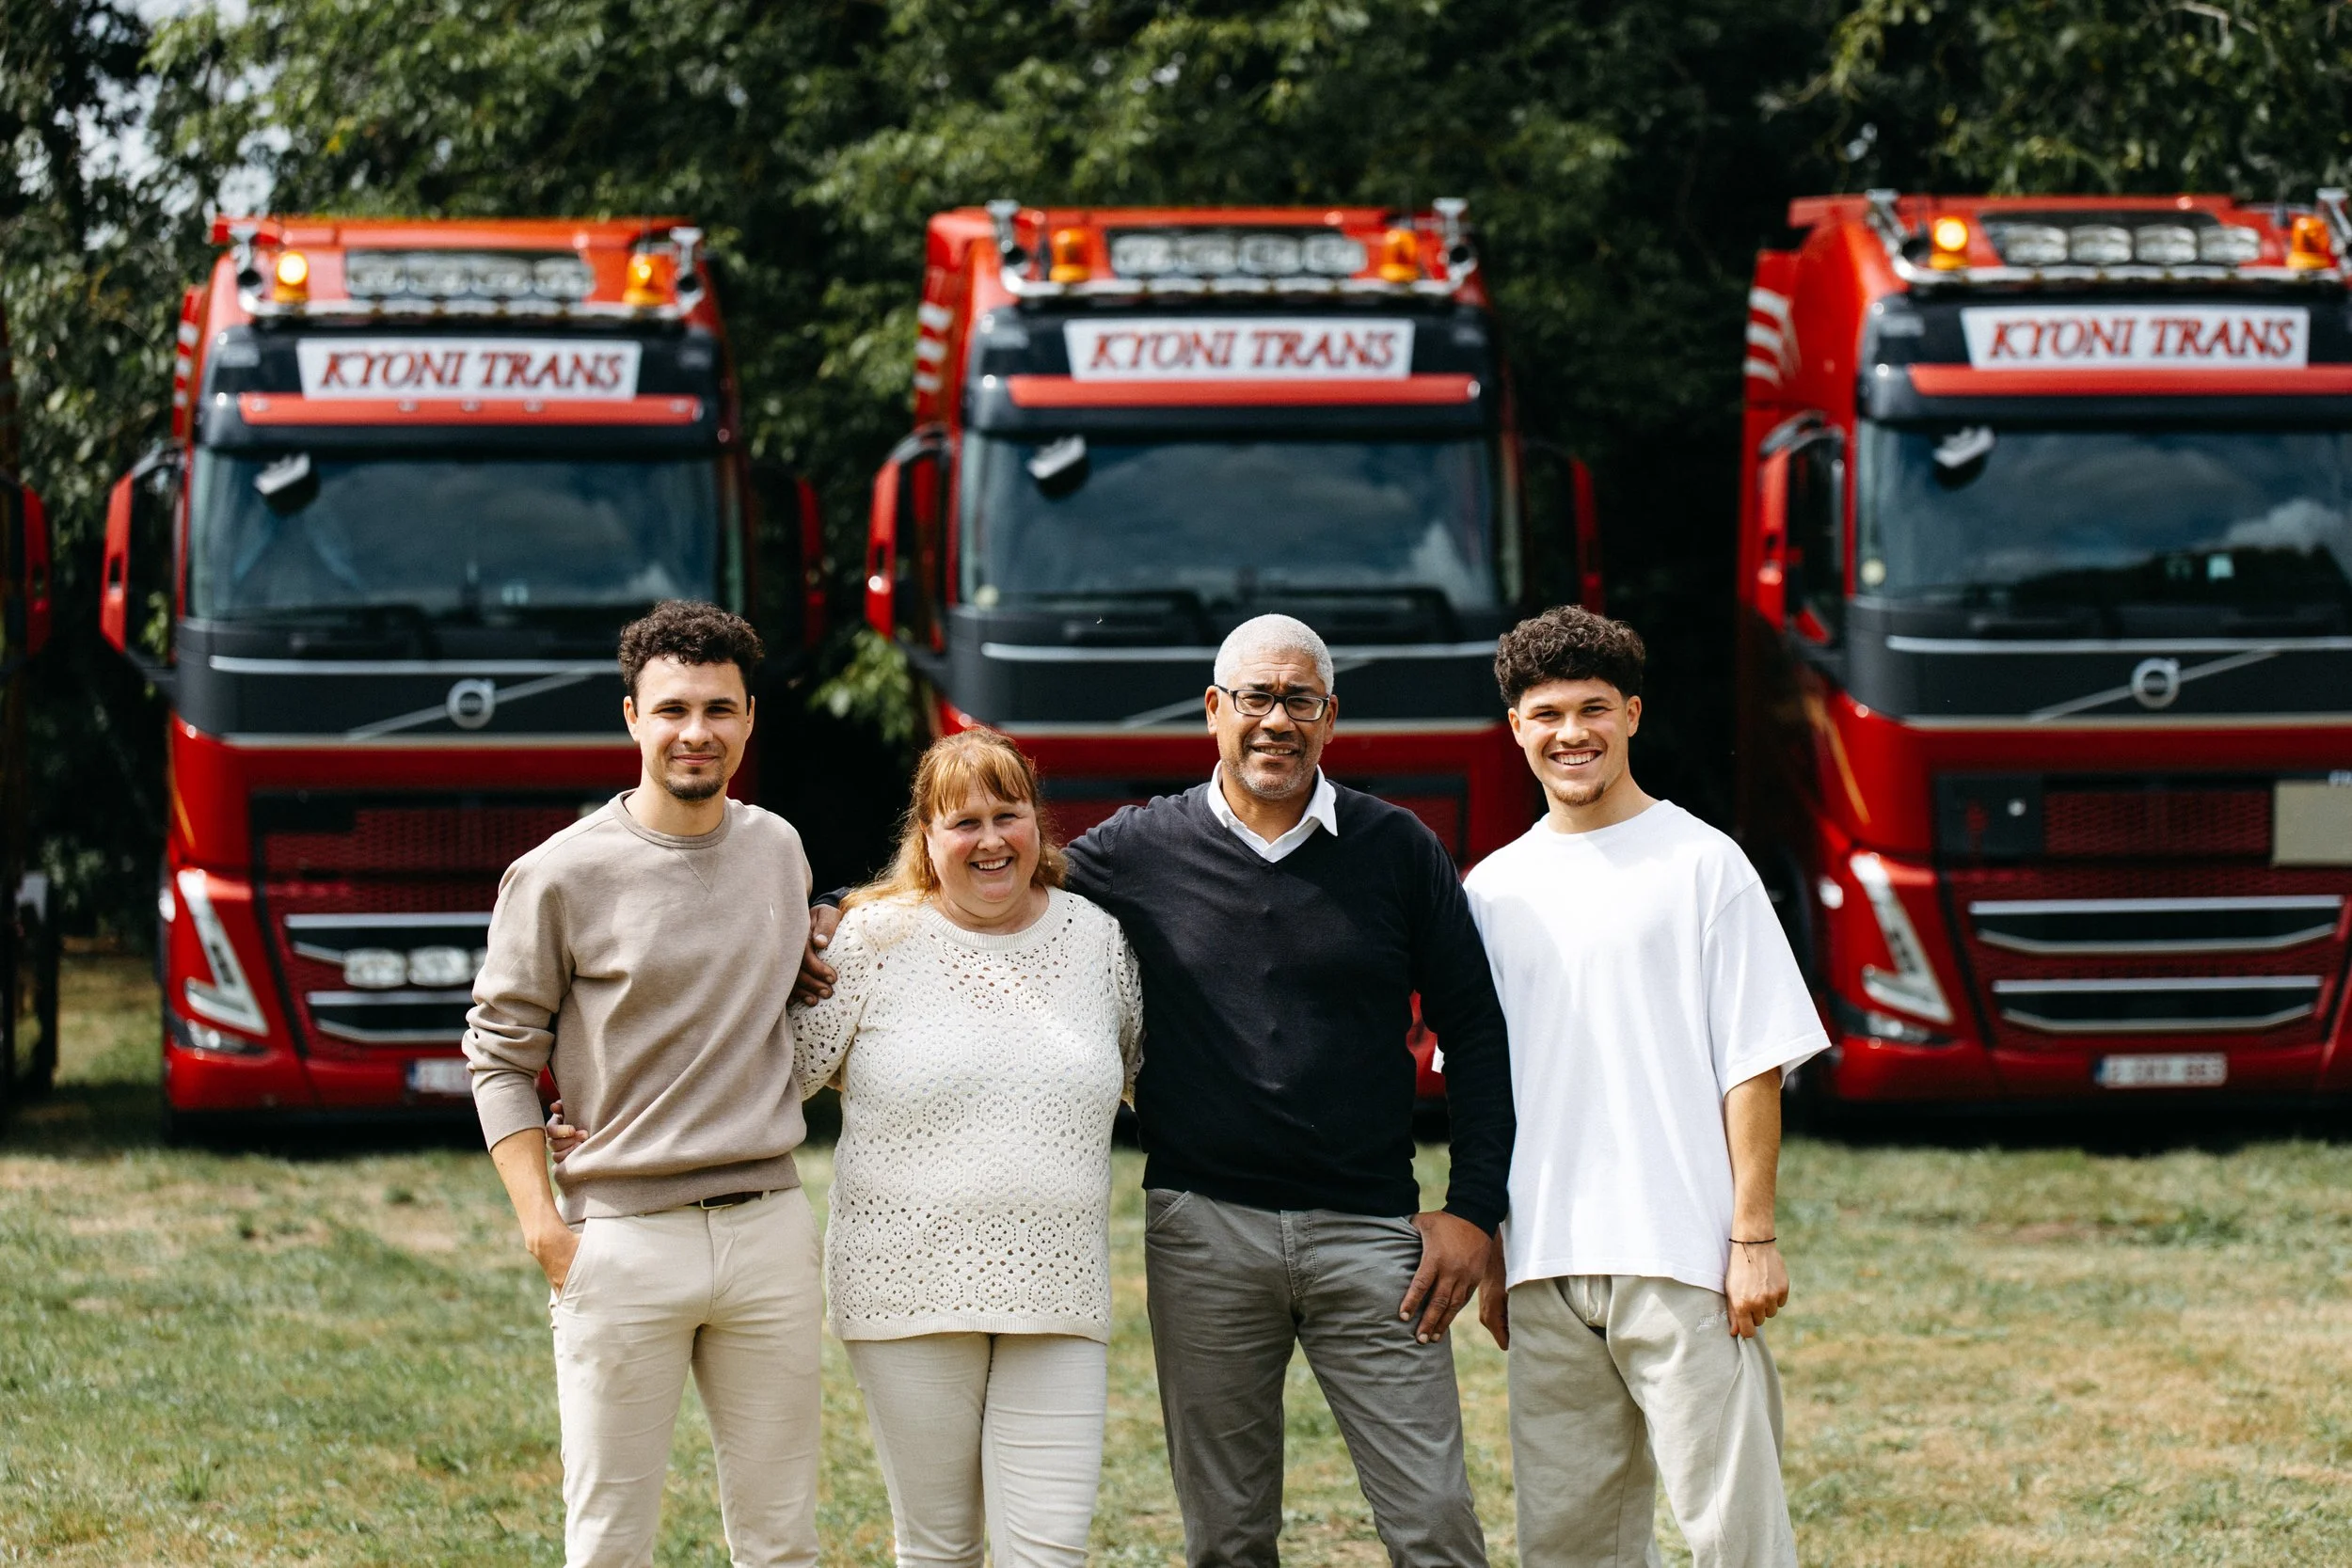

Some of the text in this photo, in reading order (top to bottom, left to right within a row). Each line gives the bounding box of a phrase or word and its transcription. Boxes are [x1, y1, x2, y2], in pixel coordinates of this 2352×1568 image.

[1089, 330, 1395, 369] KYONI TRANS
[1989, 317, 2294, 357] KYONI TRANS
[320, 350, 625, 389] KYONI TRANS
